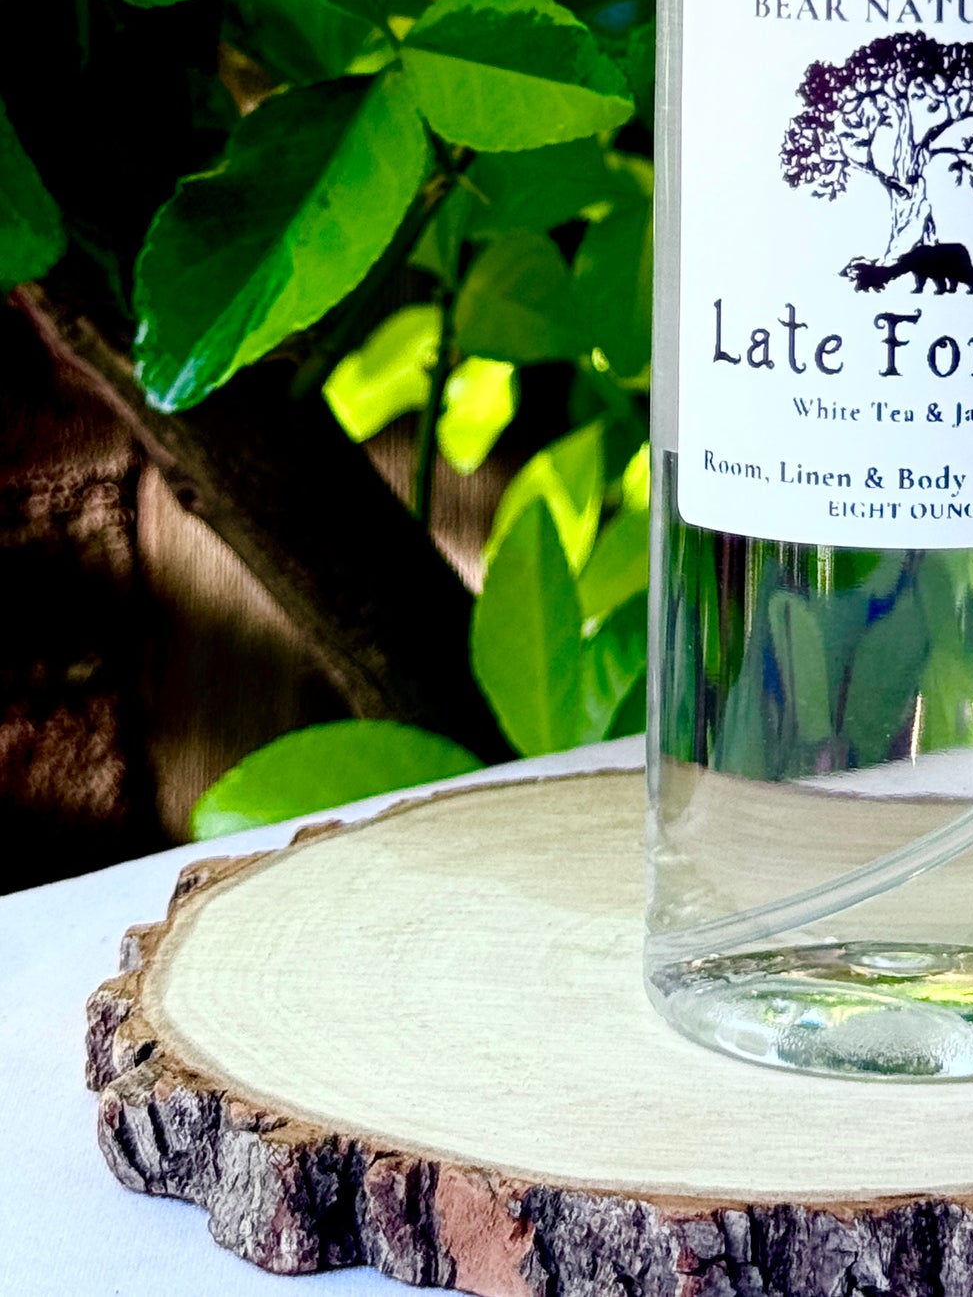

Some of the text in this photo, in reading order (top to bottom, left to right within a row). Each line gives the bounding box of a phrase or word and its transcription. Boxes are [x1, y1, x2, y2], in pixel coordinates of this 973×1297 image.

[712, 298, 844, 376] Late
[792, 396, 861, 422] White
[870, 400, 915, 423] Tea
[926, 402, 944, 423] &
[703, 449, 770, 483] Room,
[779, 460, 852, 489] Linen
[864, 466, 884, 490] &
[898, 464, 967, 499] Body
[828, 499, 902, 520] EIGHT
